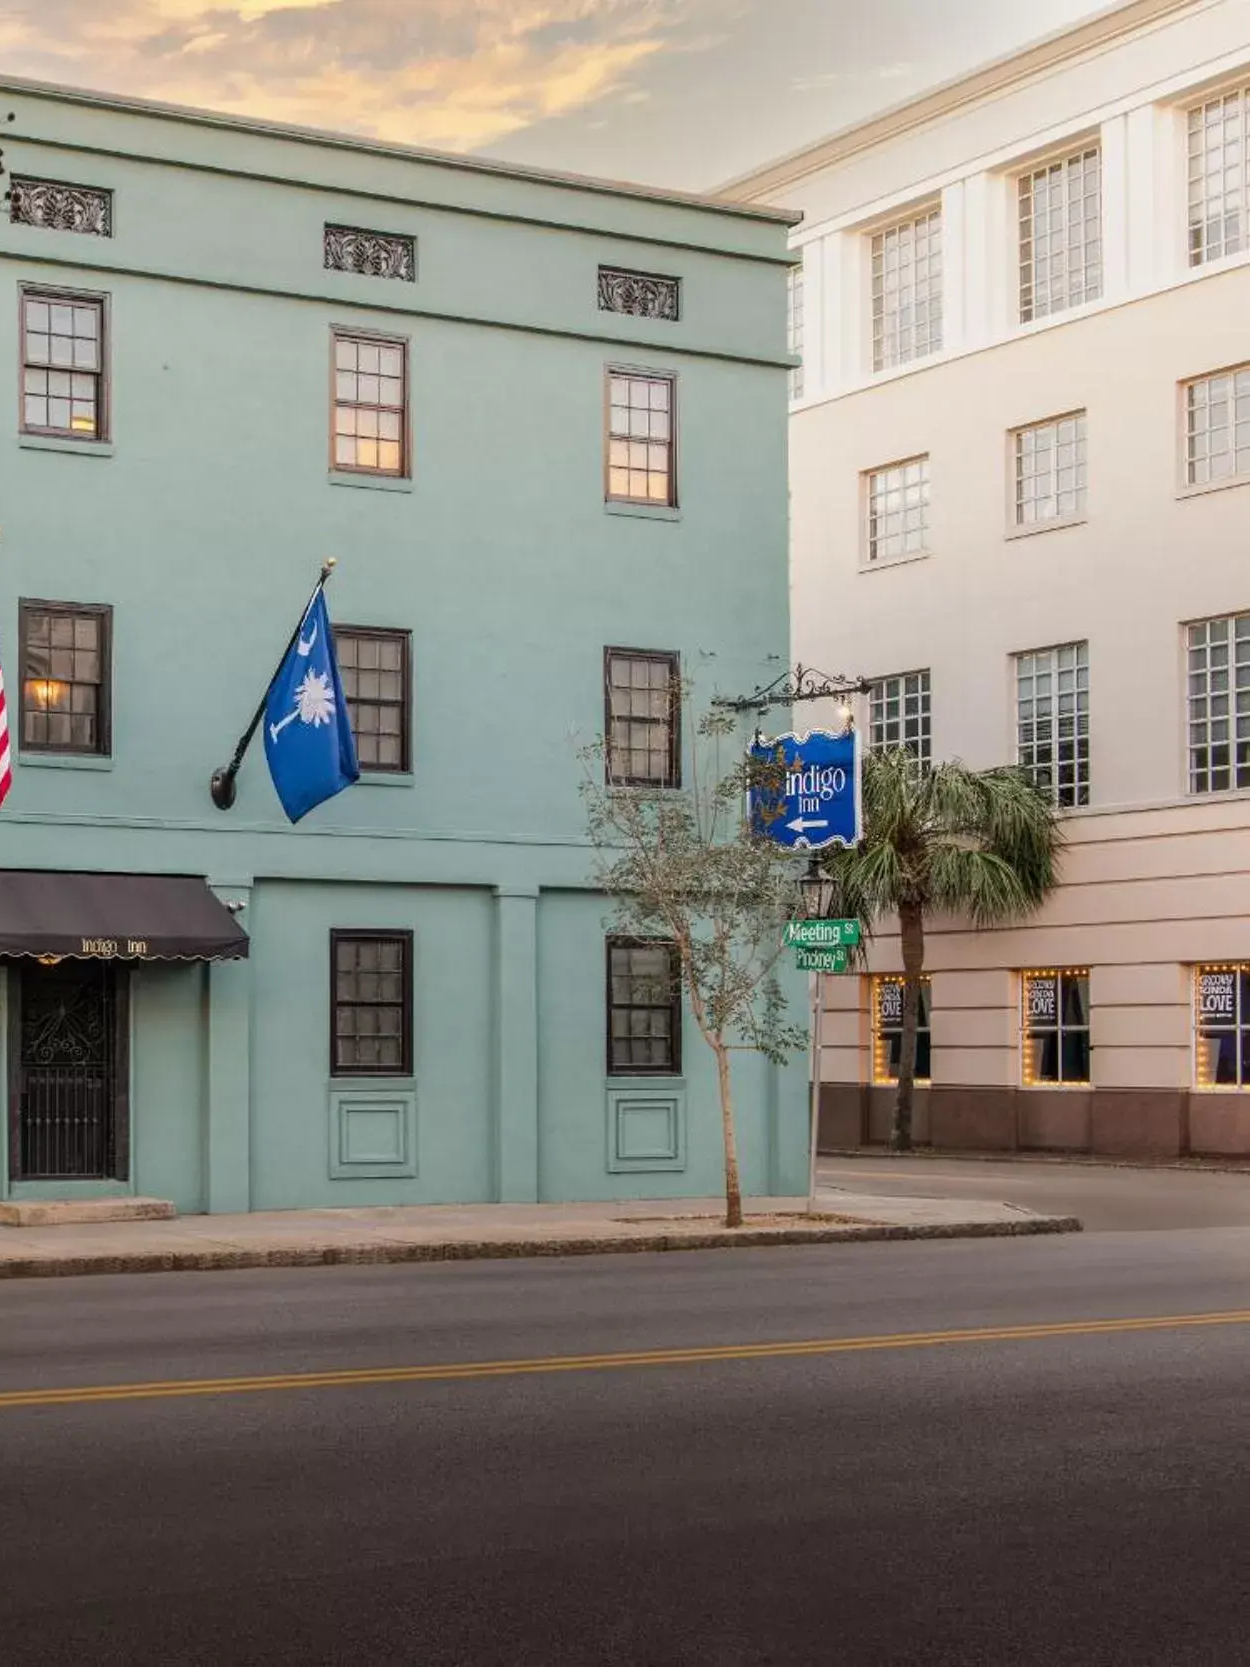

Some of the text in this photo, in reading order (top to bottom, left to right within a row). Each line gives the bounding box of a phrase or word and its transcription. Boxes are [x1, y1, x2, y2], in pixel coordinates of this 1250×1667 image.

[789, 922, 854, 944] Meeting St
[82, 938, 147, 955] Indigo Inn
[836, 950, 845, 961] St
[1200, 995, 1233, 1011] LOVE
